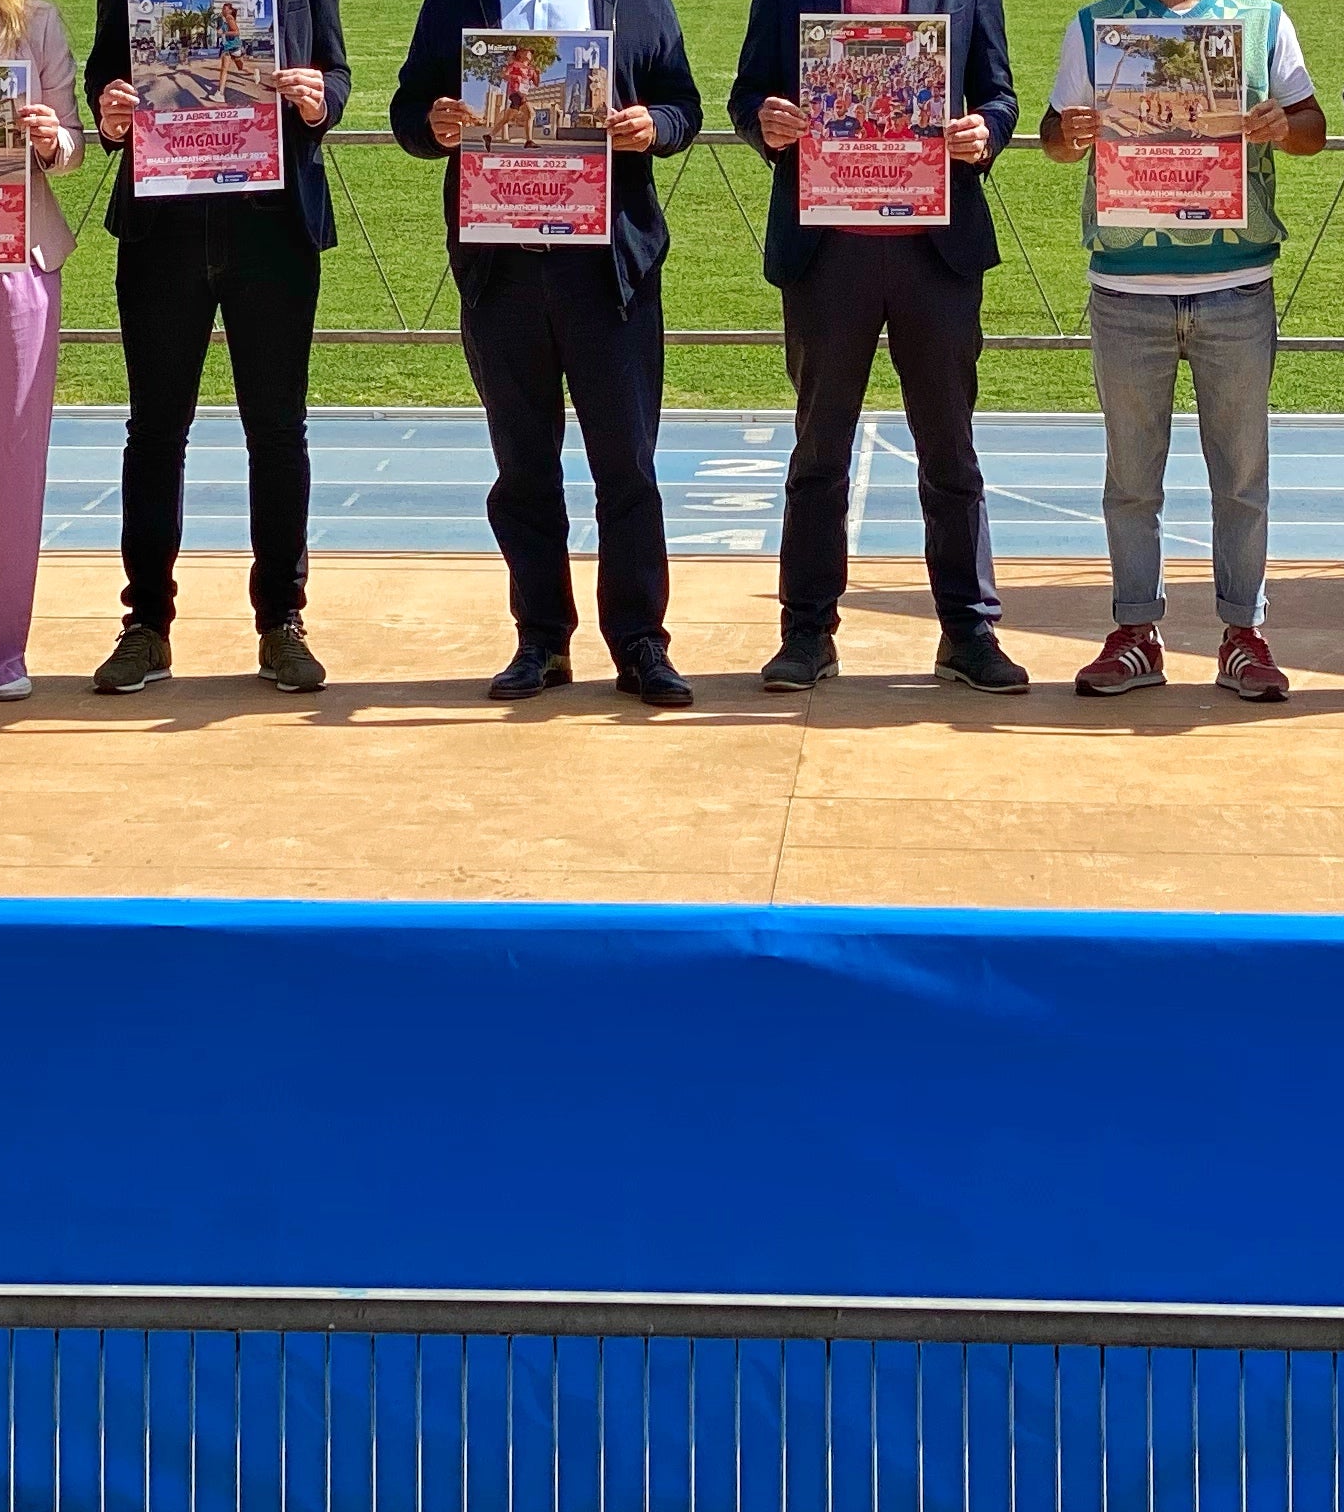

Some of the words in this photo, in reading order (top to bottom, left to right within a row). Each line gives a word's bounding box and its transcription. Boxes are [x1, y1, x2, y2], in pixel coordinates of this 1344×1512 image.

[215, 111, 238, 119] 2022
[172, 133, 239, 148] MAGALUF
[544, 160, 567, 168] 2022
[839, 166, 905, 178] MAGALUF
[1135, 170, 1203, 182] MAGALUF
[499, 183, 566, 195] MAGALUF
